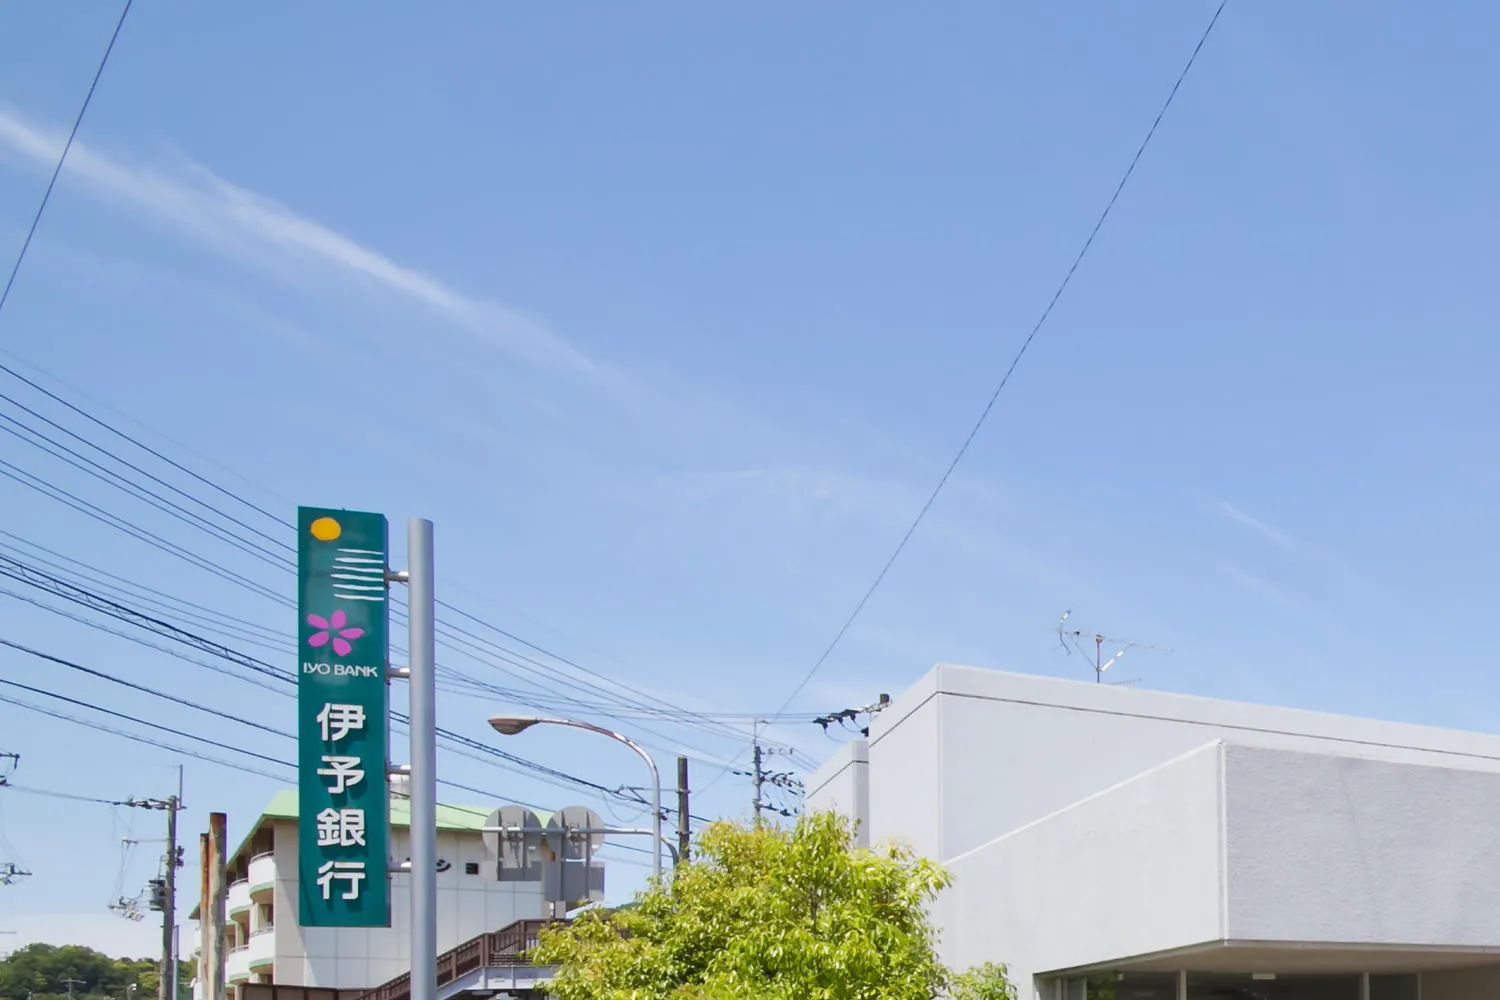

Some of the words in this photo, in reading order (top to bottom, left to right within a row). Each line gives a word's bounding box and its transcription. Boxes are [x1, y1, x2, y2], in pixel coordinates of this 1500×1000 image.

[303, 662, 331, 675] IYO
[334, 664, 378, 678] BANK
[316, 702, 367, 900] 伊予銀行
